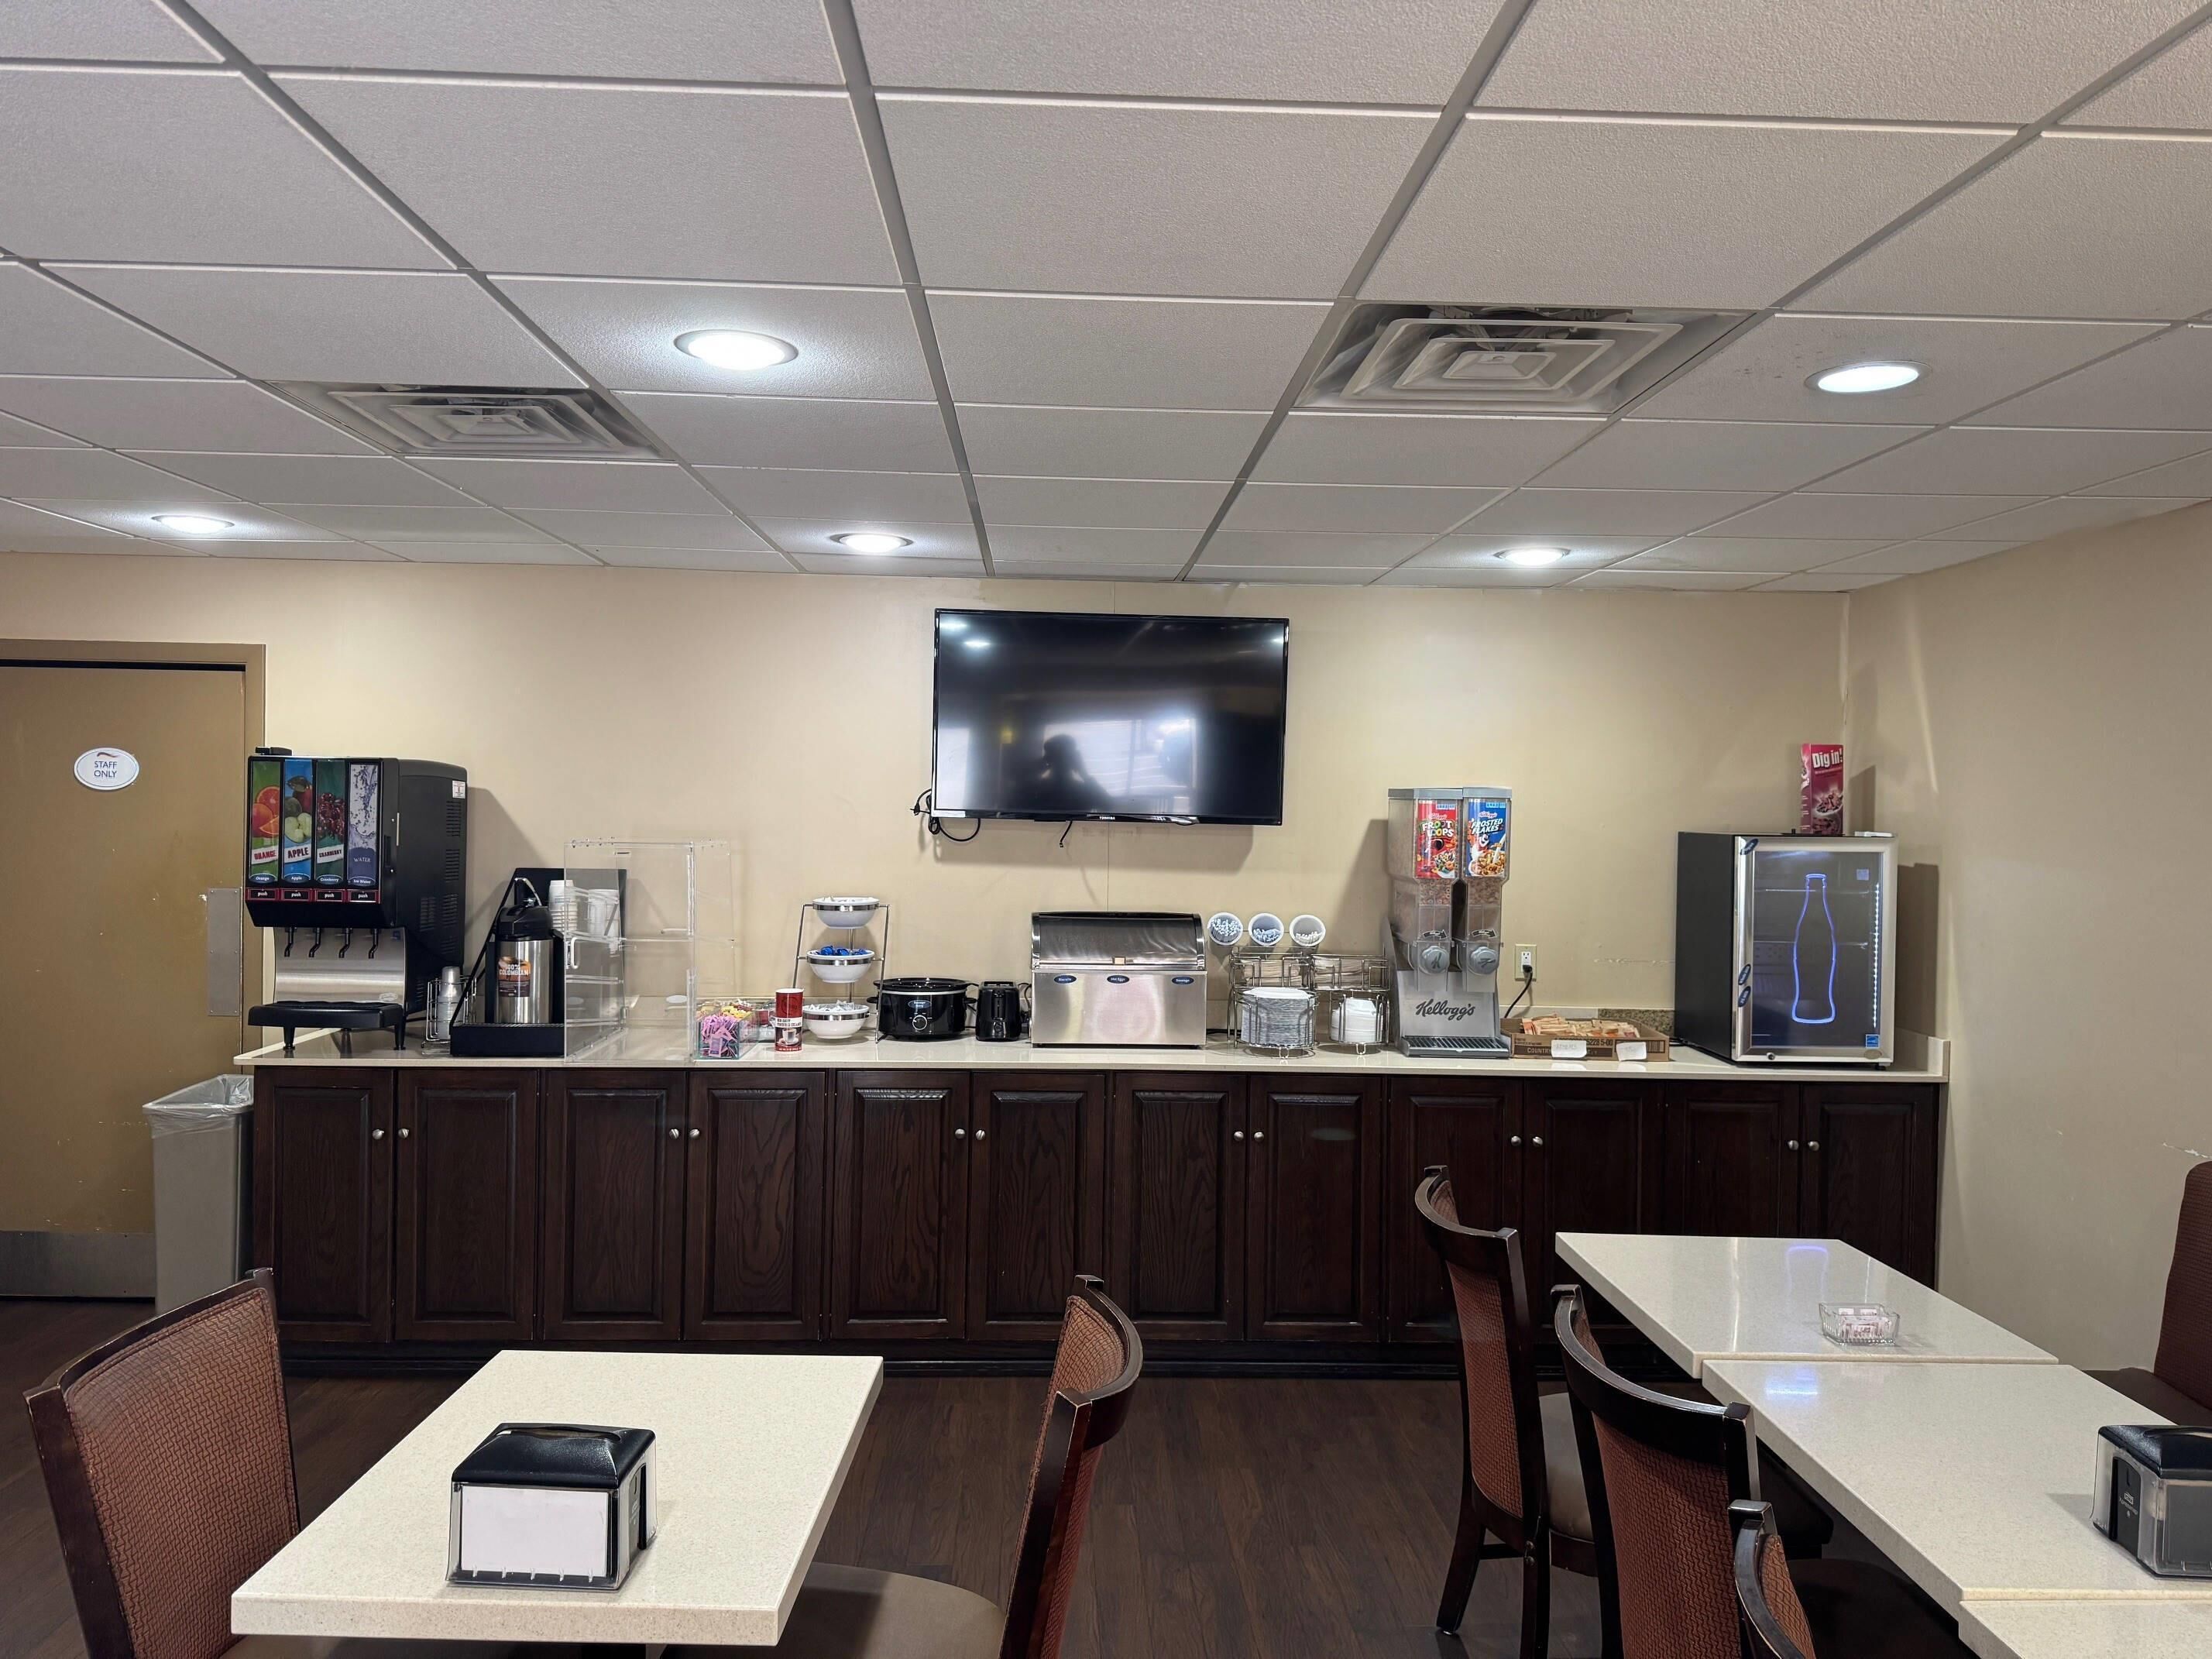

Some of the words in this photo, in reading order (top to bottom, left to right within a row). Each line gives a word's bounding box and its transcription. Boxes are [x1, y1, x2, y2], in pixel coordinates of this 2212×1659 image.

[1812, 752, 1830, 768] Dig
[1831, 748, 1843, 764] in!
[94, 761, 117, 769] STAFF
[1422, 821, 1452, 832] FROOT
[1471, 818, 1503, 830] FROSTED
[1427, 828, 1454, 837] LOOPS
[1472, 825, 1499, 835] FLAKES
[254, 850, 277, 860] ORANGE
[287, 847, 309, 859] APPLE
[1416, 998, 1475, 1021] Kellogg's
